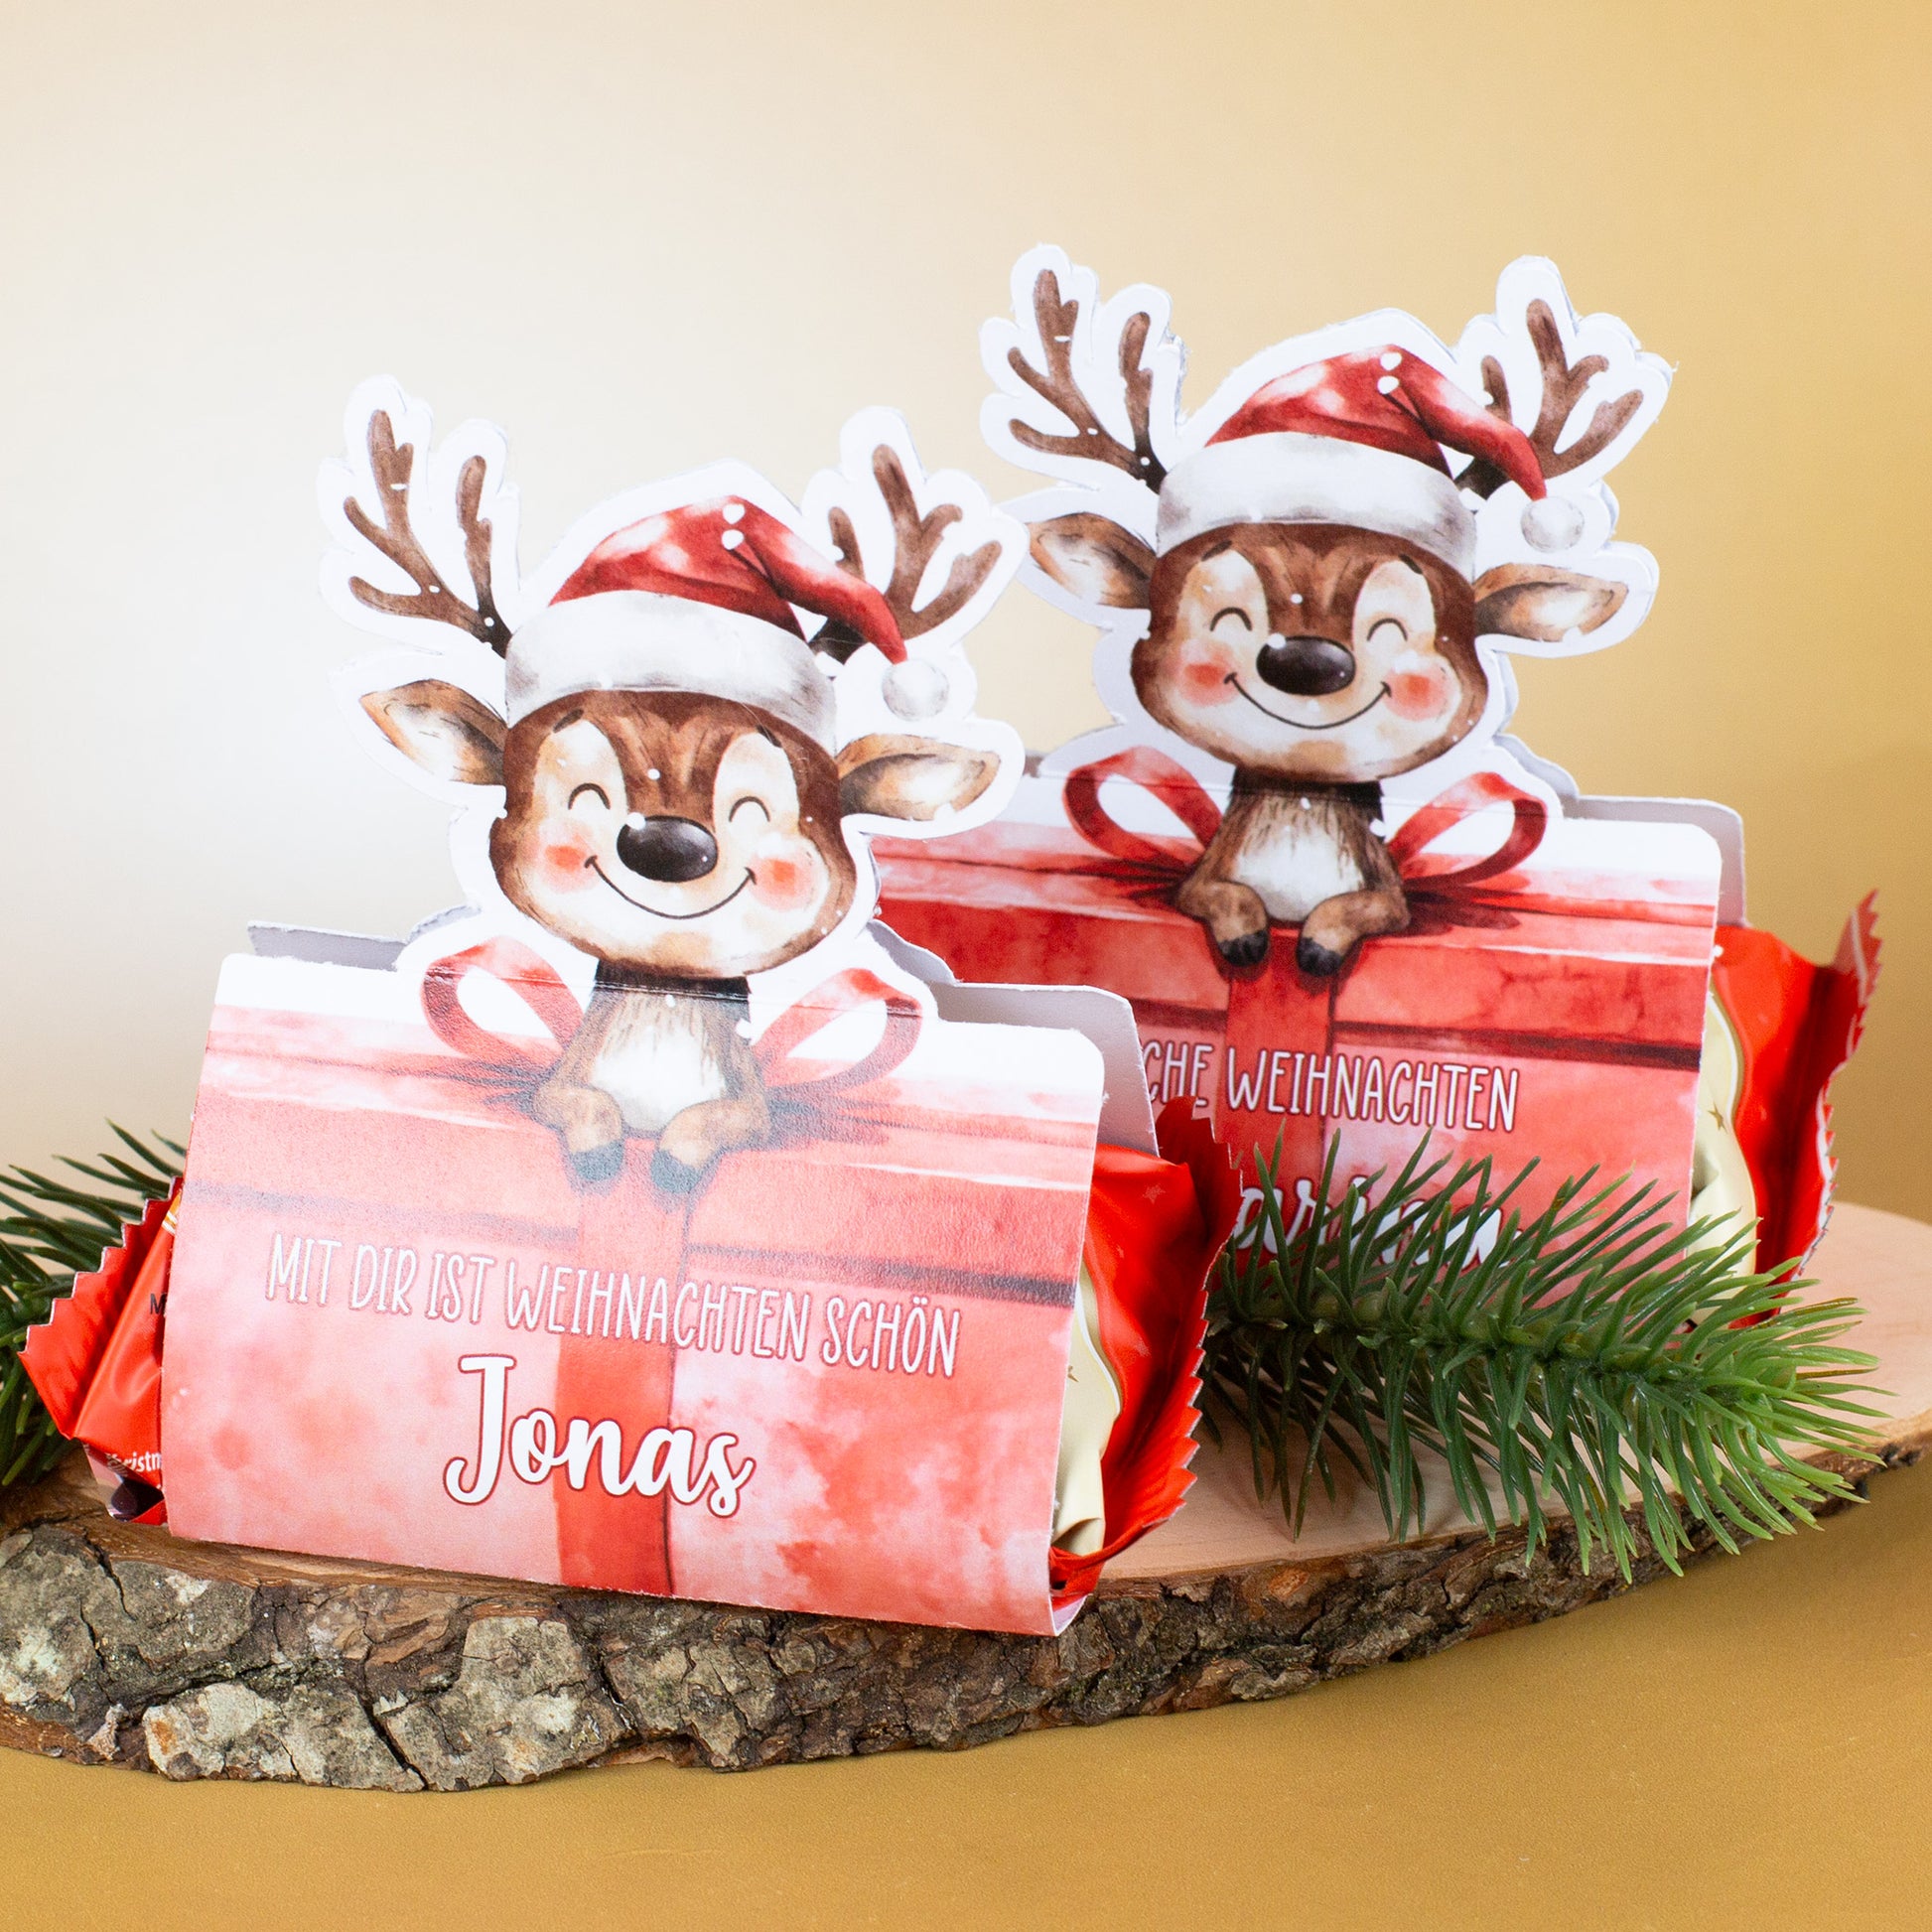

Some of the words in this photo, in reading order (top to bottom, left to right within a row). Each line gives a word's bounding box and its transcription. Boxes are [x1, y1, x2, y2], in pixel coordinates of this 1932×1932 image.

[1226, 1045, 1520, 1132] WEIHNACHTEN
[265, 1232, 342, 1306] MIT
[347, 1244, 418, 1314] DIR
[425, 1252, 495, 1323] IST
[504, 1260, 813, 1363] WEIHNACHTEN
[822, 1294, 962, 1378] SCHÖN
[443, 1353, 758, 1519] Jonas
